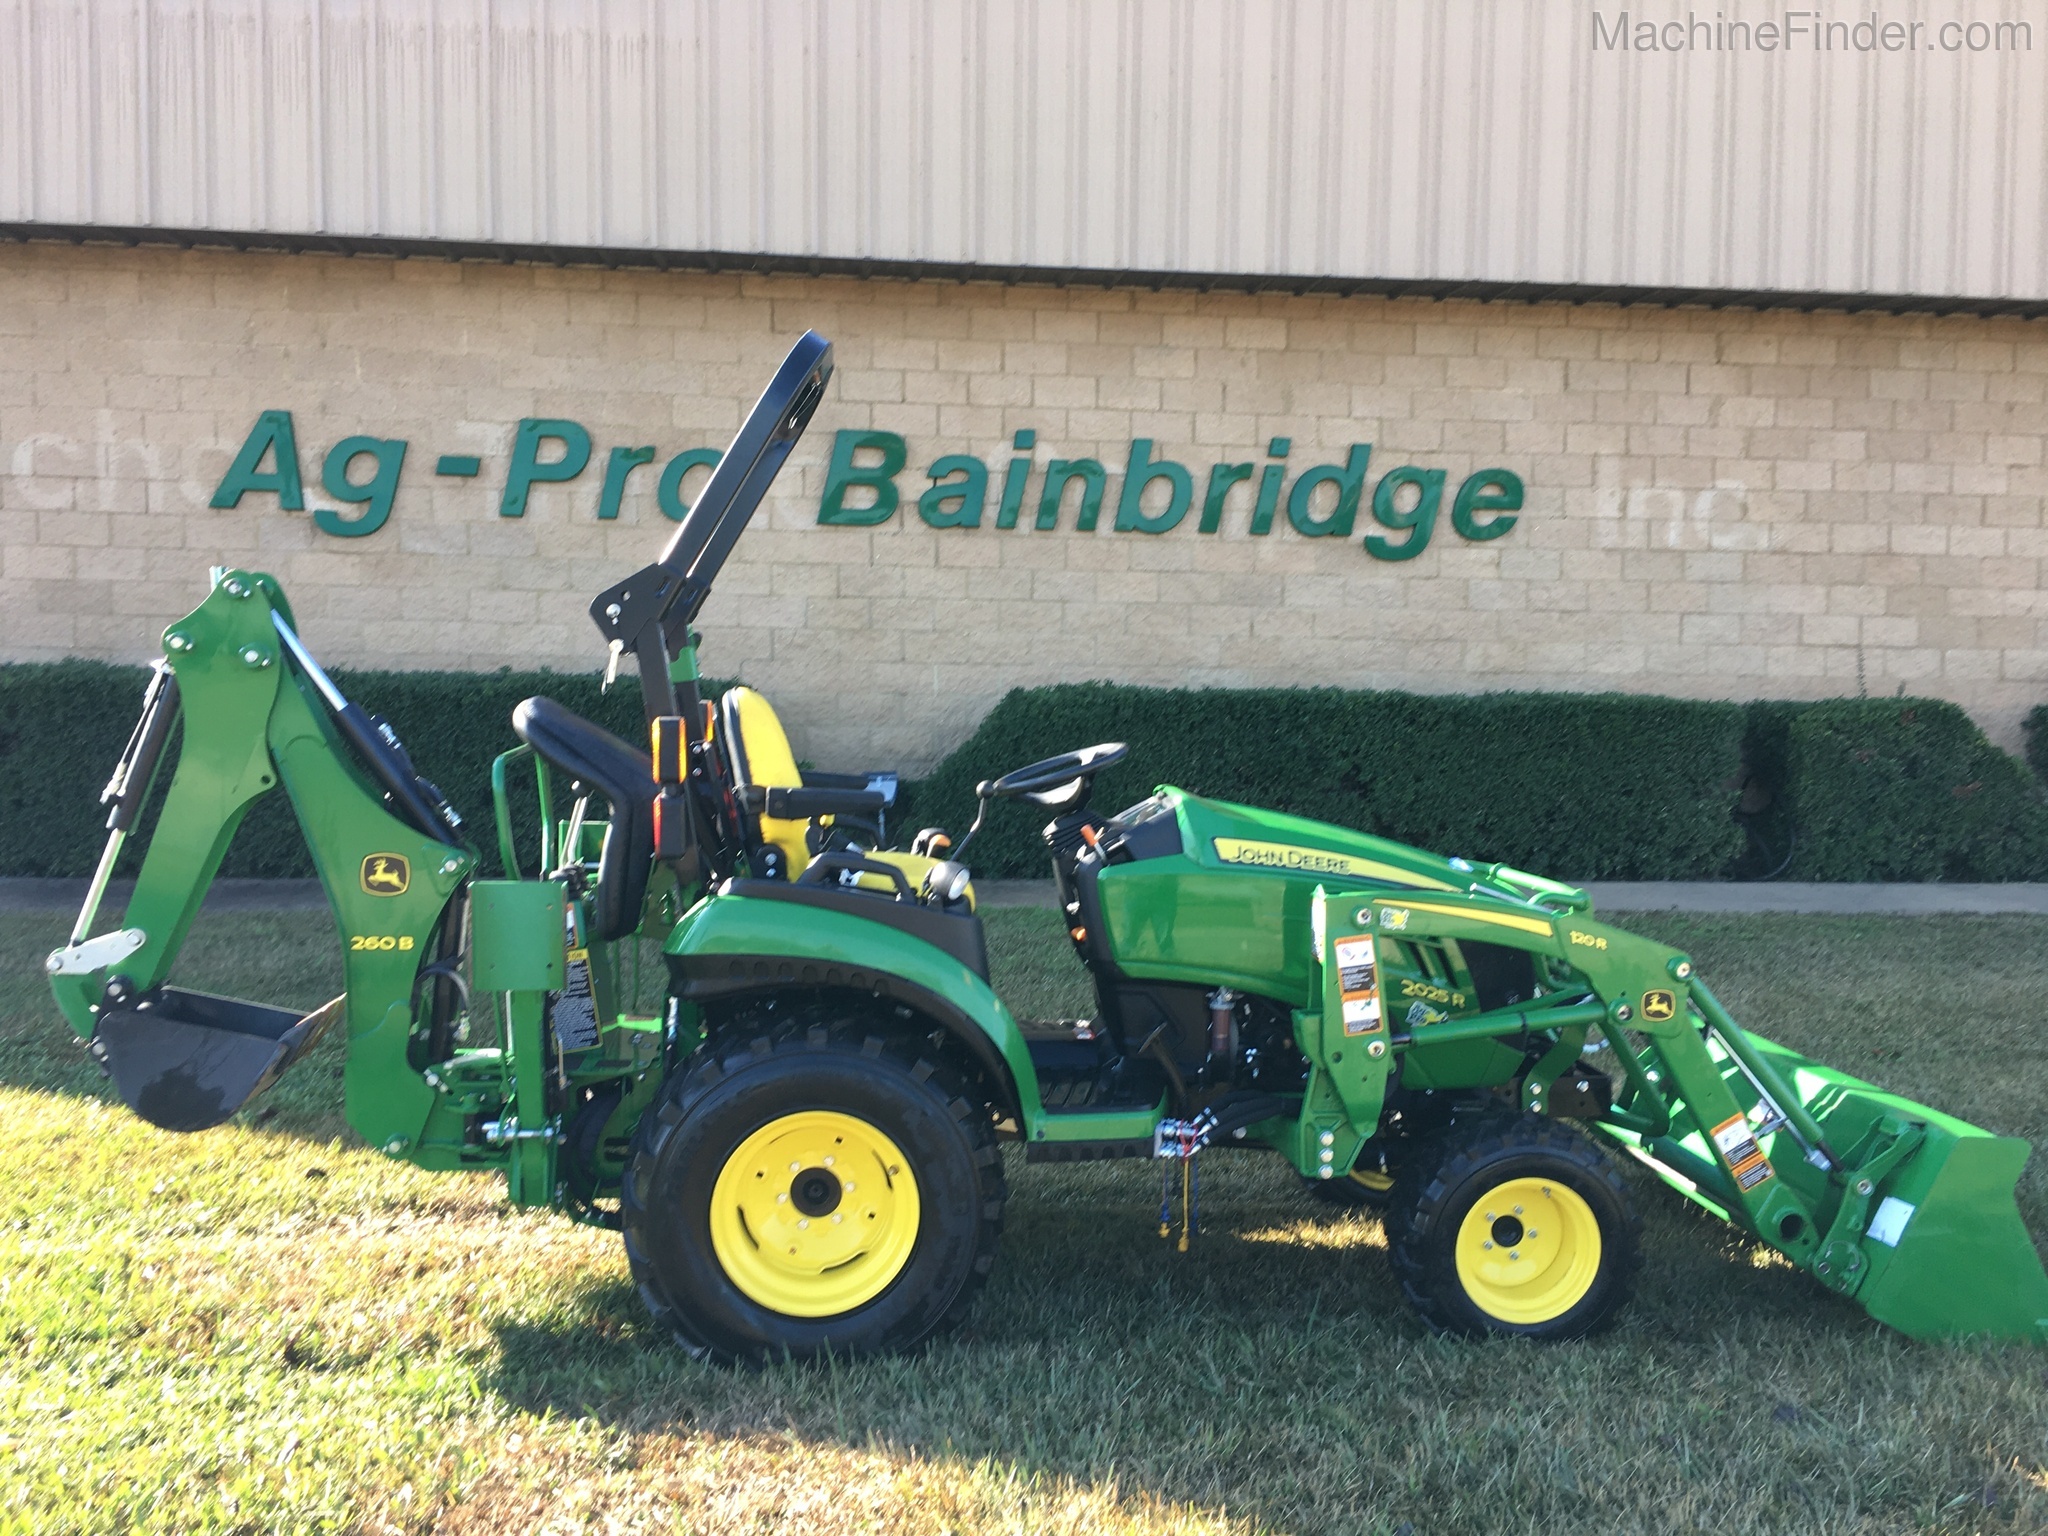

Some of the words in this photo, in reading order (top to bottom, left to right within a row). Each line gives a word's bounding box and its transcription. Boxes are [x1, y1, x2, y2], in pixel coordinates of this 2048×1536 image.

[816, 427, 1526, 562] Bainbridge
[1228, 845, 1285, 868] JOHN
[1285, 849, 1353, 876] DEERE
